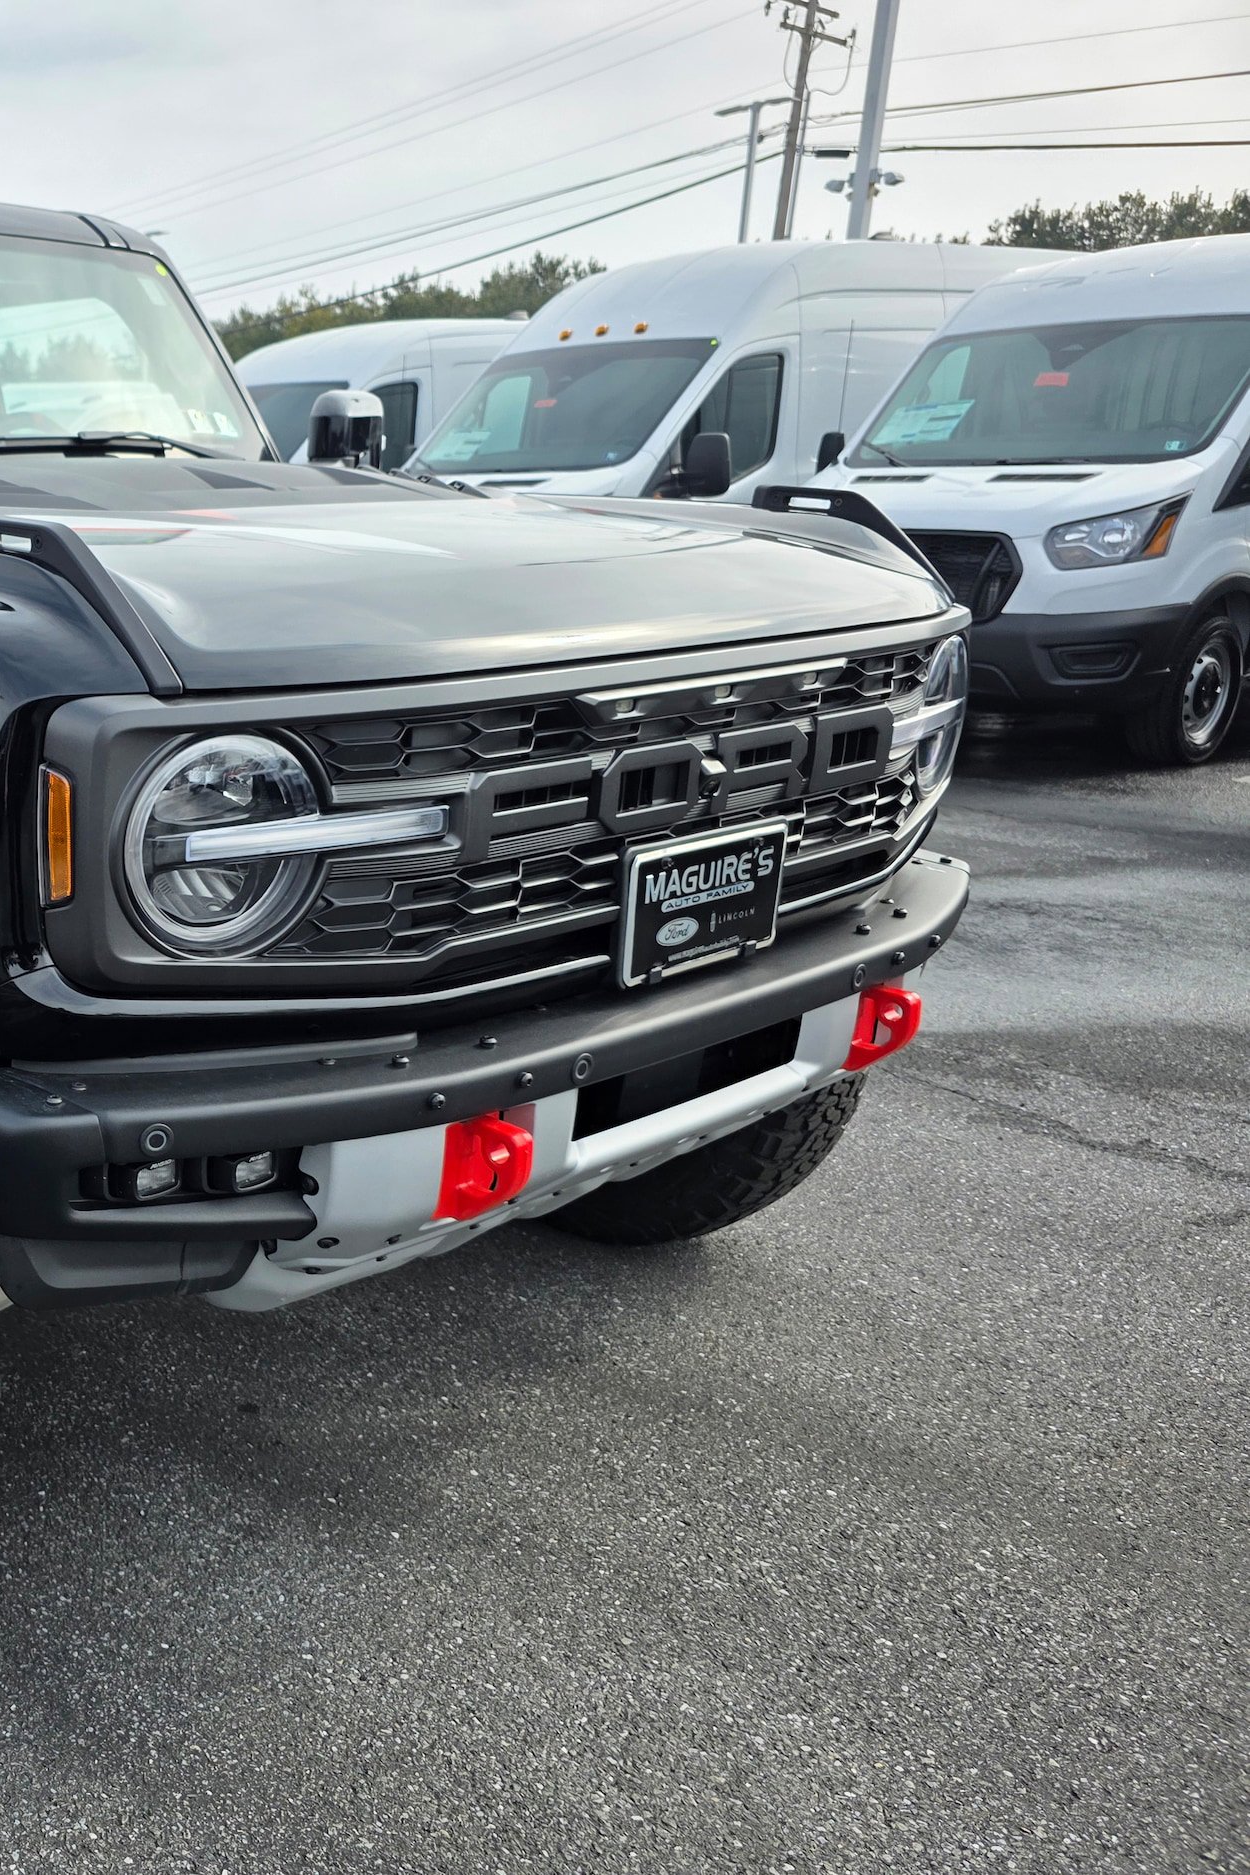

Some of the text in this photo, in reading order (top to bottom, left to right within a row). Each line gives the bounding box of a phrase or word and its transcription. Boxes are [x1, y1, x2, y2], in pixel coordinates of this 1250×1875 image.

[459, 705, 894, 864] FORD
[645, 848, 774, 904] MAGUIRE'S
[666, 884, 751, 909] AUTO FAMILY
[718, 908, 756, 924] LINCOLN
